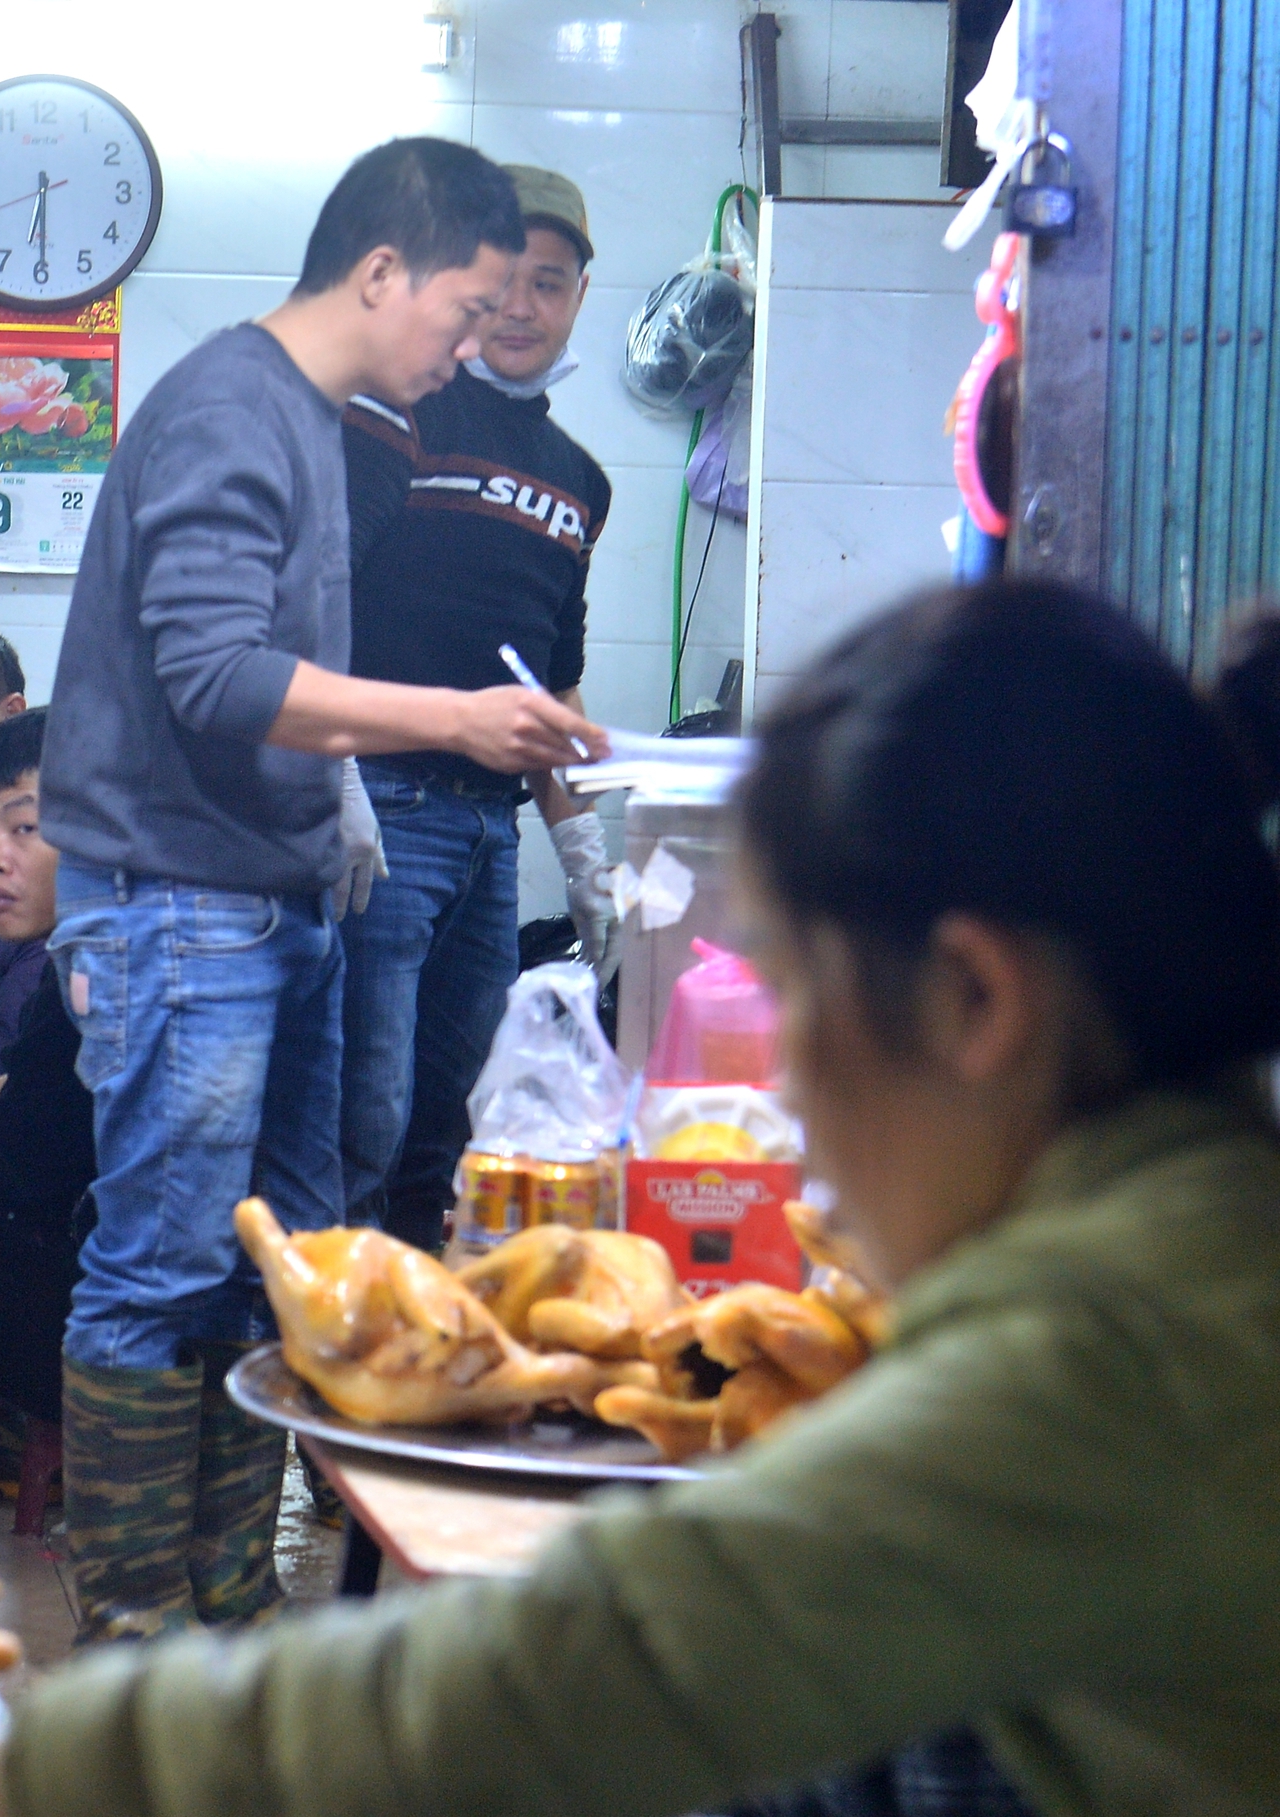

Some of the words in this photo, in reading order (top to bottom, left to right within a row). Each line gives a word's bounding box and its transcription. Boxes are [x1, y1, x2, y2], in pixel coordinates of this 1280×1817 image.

[29, 100, 57, 124] 12
[79, 110, 89, 133] 1
[103, 142, 121, 166] 2
[115, 180, 132, 204] 3
[103, 220, 120, 245] 4
[33, 260, 49, 284] 6
[76, 250, 92, 274] 5
[62, 492, 83, 510] 22
[480, 475, 585, 543] sup
